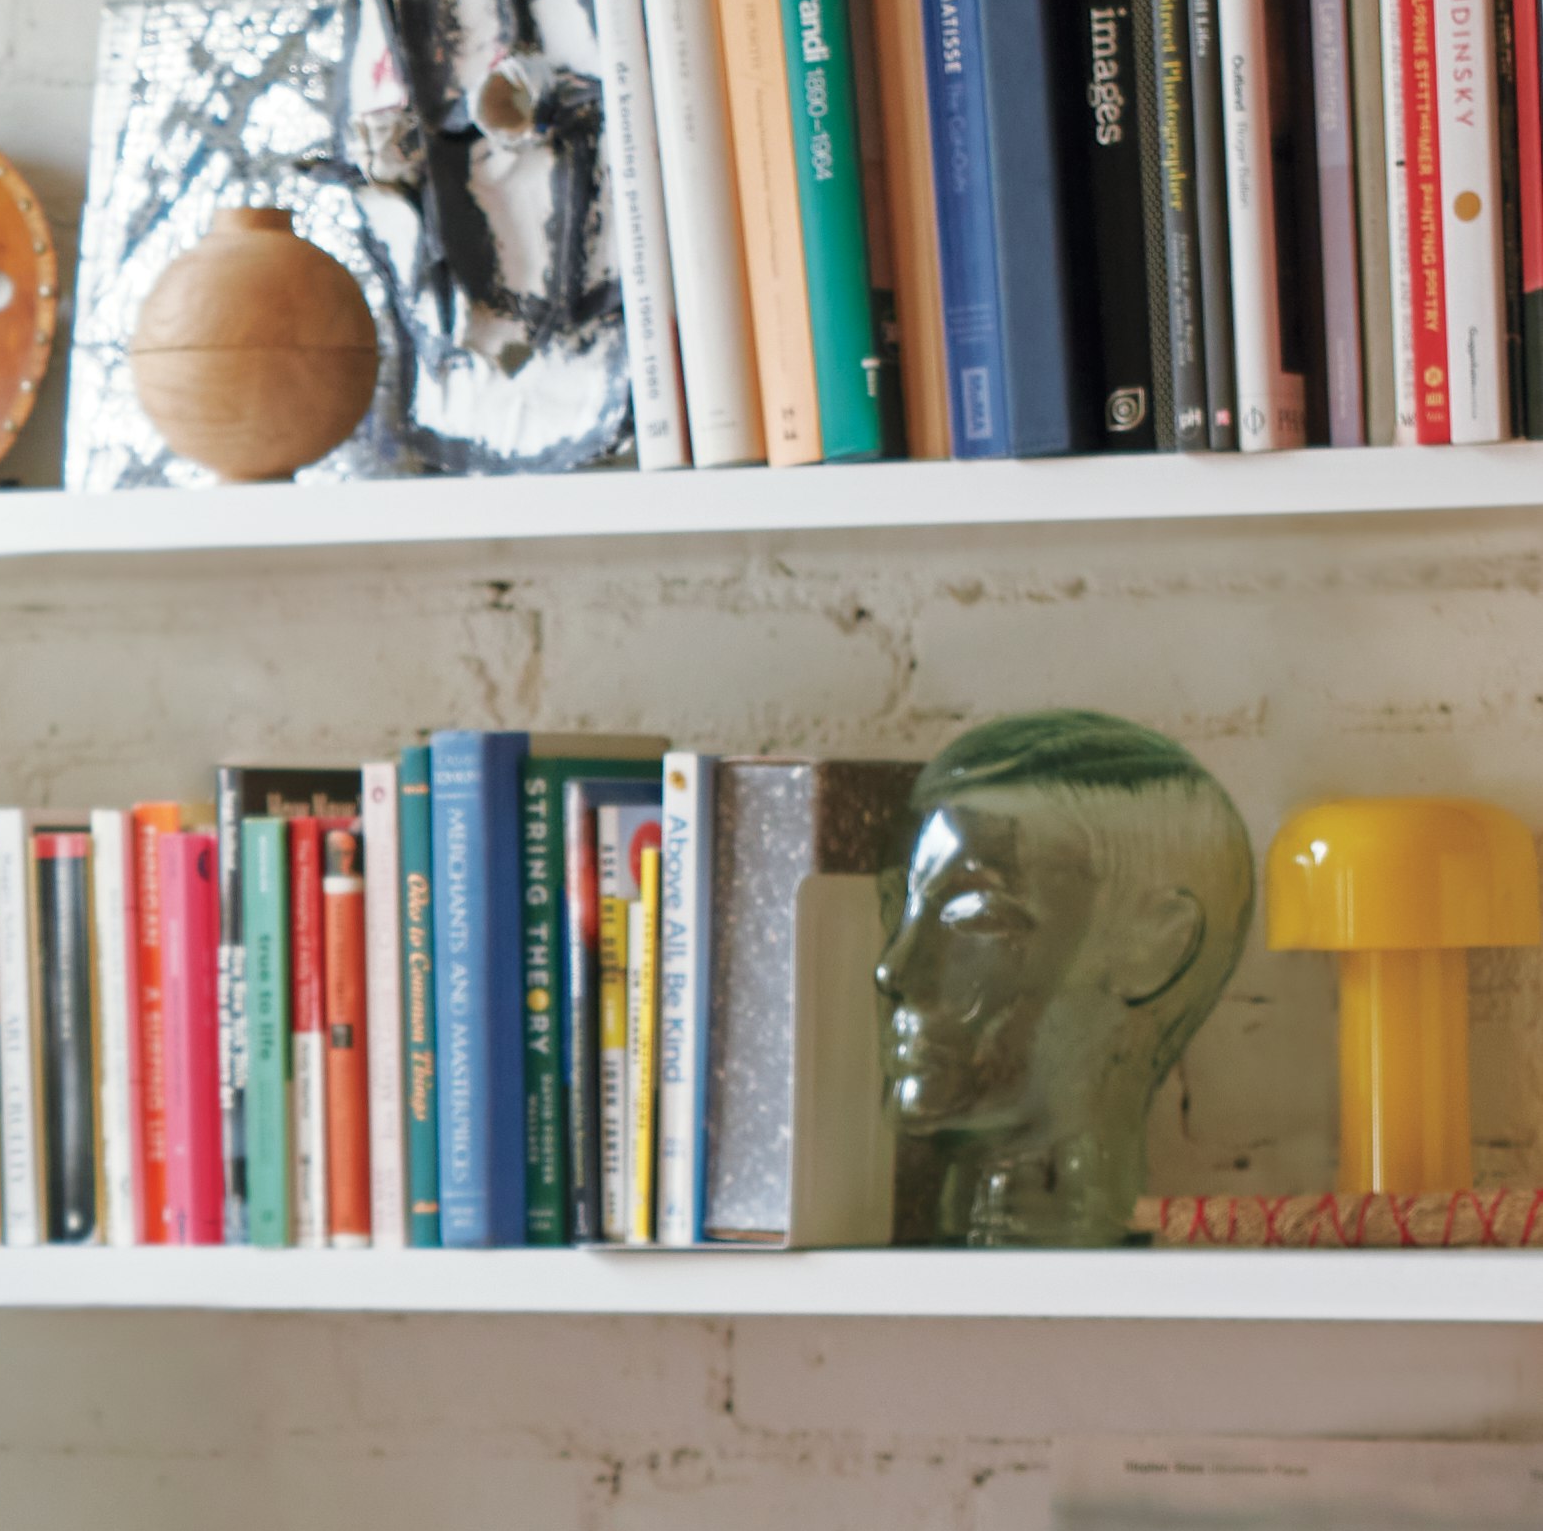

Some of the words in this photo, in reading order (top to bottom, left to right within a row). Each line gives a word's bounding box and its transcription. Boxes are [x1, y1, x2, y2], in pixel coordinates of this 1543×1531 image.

[615, 60, 633, 86] de
[1086, 7, 1127, 145] images
[1232, 55, 1248, 111] Outland
[1161, 58, 1188, 212] Photographer
[1419, 182, 1439, 264] PAINTING
[446, 808, 470, 953] MERCHANTS
[524, 778, 547, 906] STRING
[666, 814, 689, 910] Above
[448, 960, 471, 1017] AND
[665, 973, 686, 1009] Be
[410, 1051, 433, 1122] Things
[665, 1018, 688, 1085] Kind
[449, 1023, 474, 1186] MASTERPIECES
